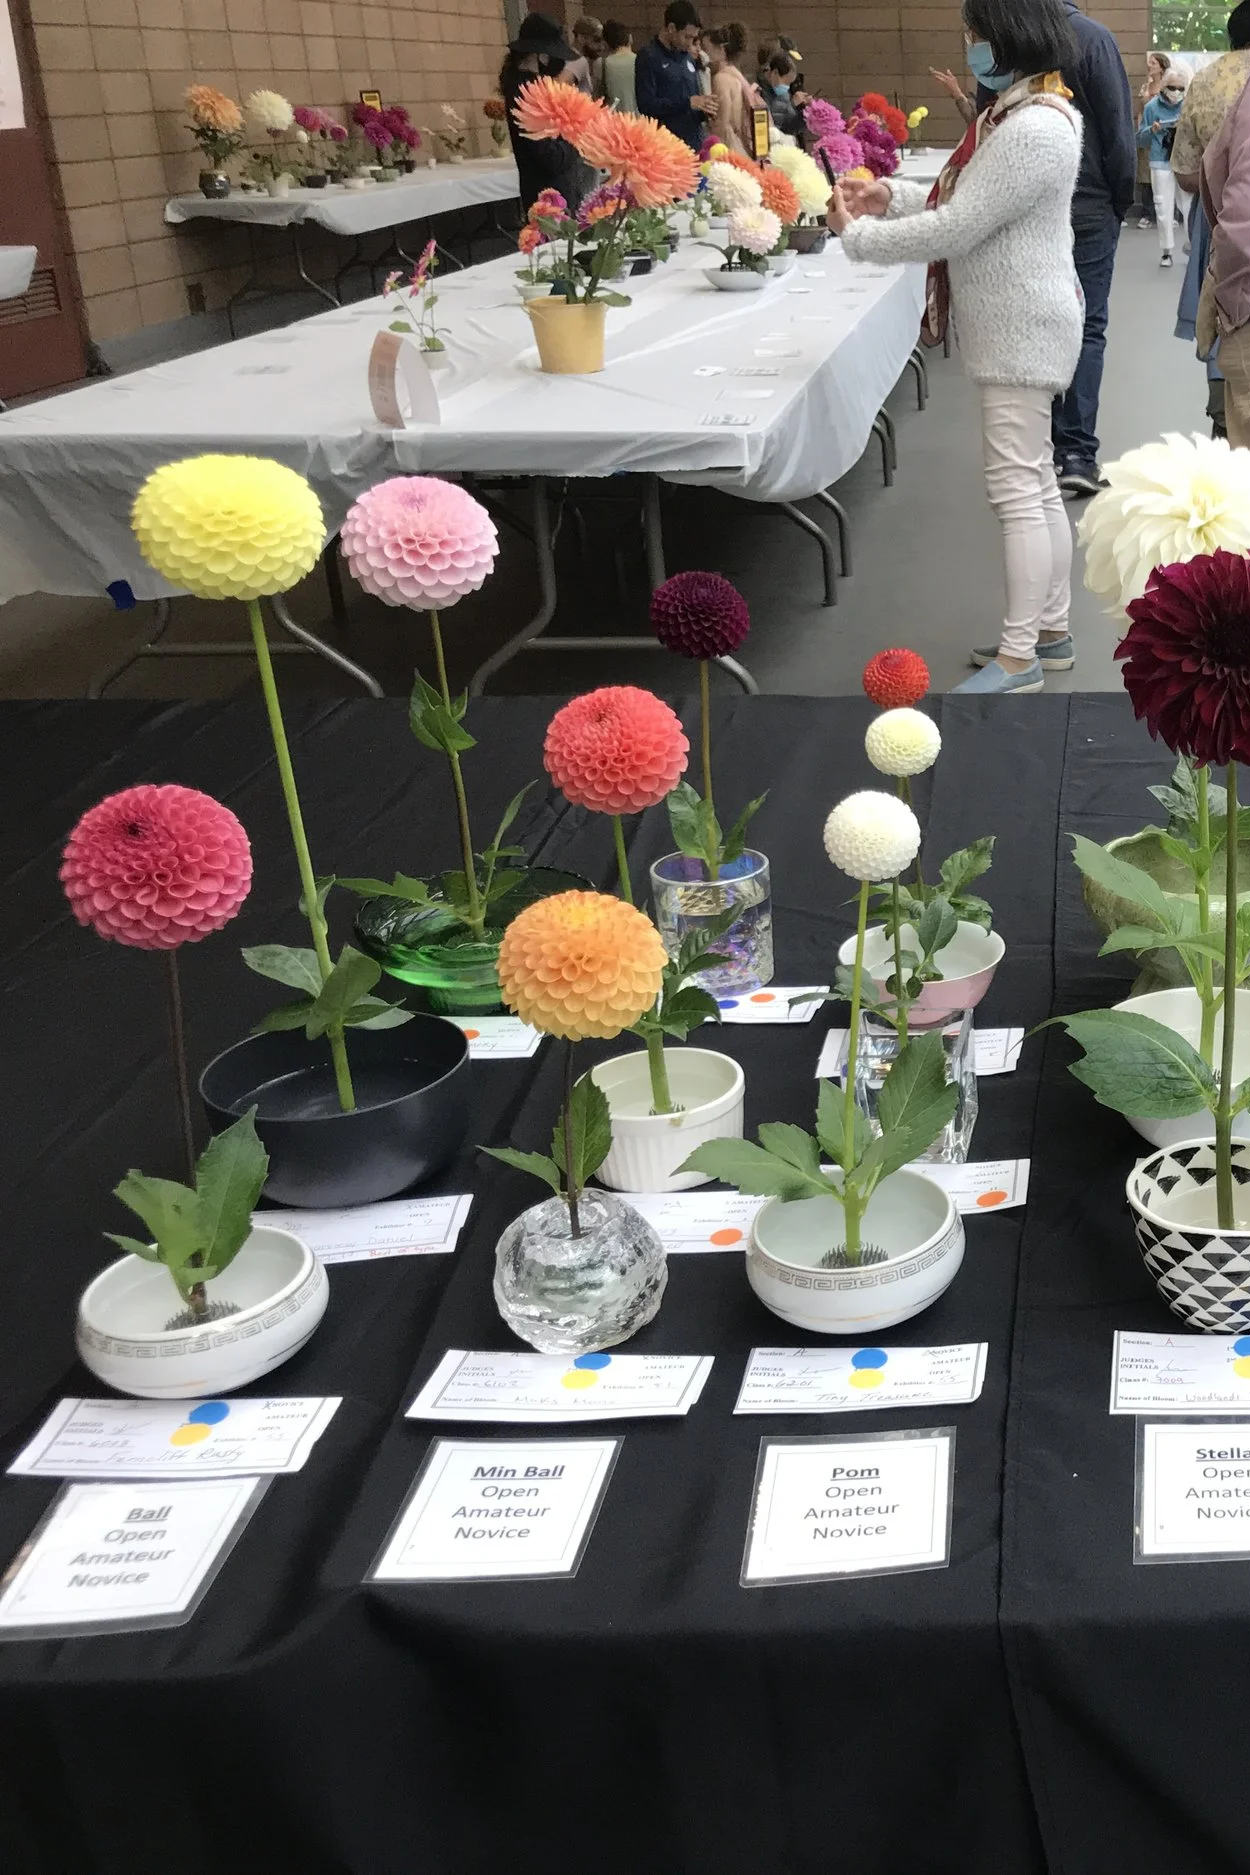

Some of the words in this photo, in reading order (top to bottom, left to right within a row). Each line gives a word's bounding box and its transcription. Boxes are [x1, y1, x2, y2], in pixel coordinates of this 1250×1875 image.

[473, 1466, 516, 1478] Min
[523, 1465, 566, 1478] Ball
[831, 1465, 880, 1479] Pom
[480, 1485, 540, 1500] Open
[824, 1484, 883, 1500] Open
[126, 1505, 173, 1521] Ball
[451, 1505, 551, 1519] Amateur
[803, 1503, 900, 1520] Amateur
[103, 1528, 166, 1544] Open
[453, 1525, 531, 1540] Novice
[812, 1523, 888, 1540] Novice
[68, 1547, 175, 1567] Amateur
[67, 1569, 150, 1589] Novice
